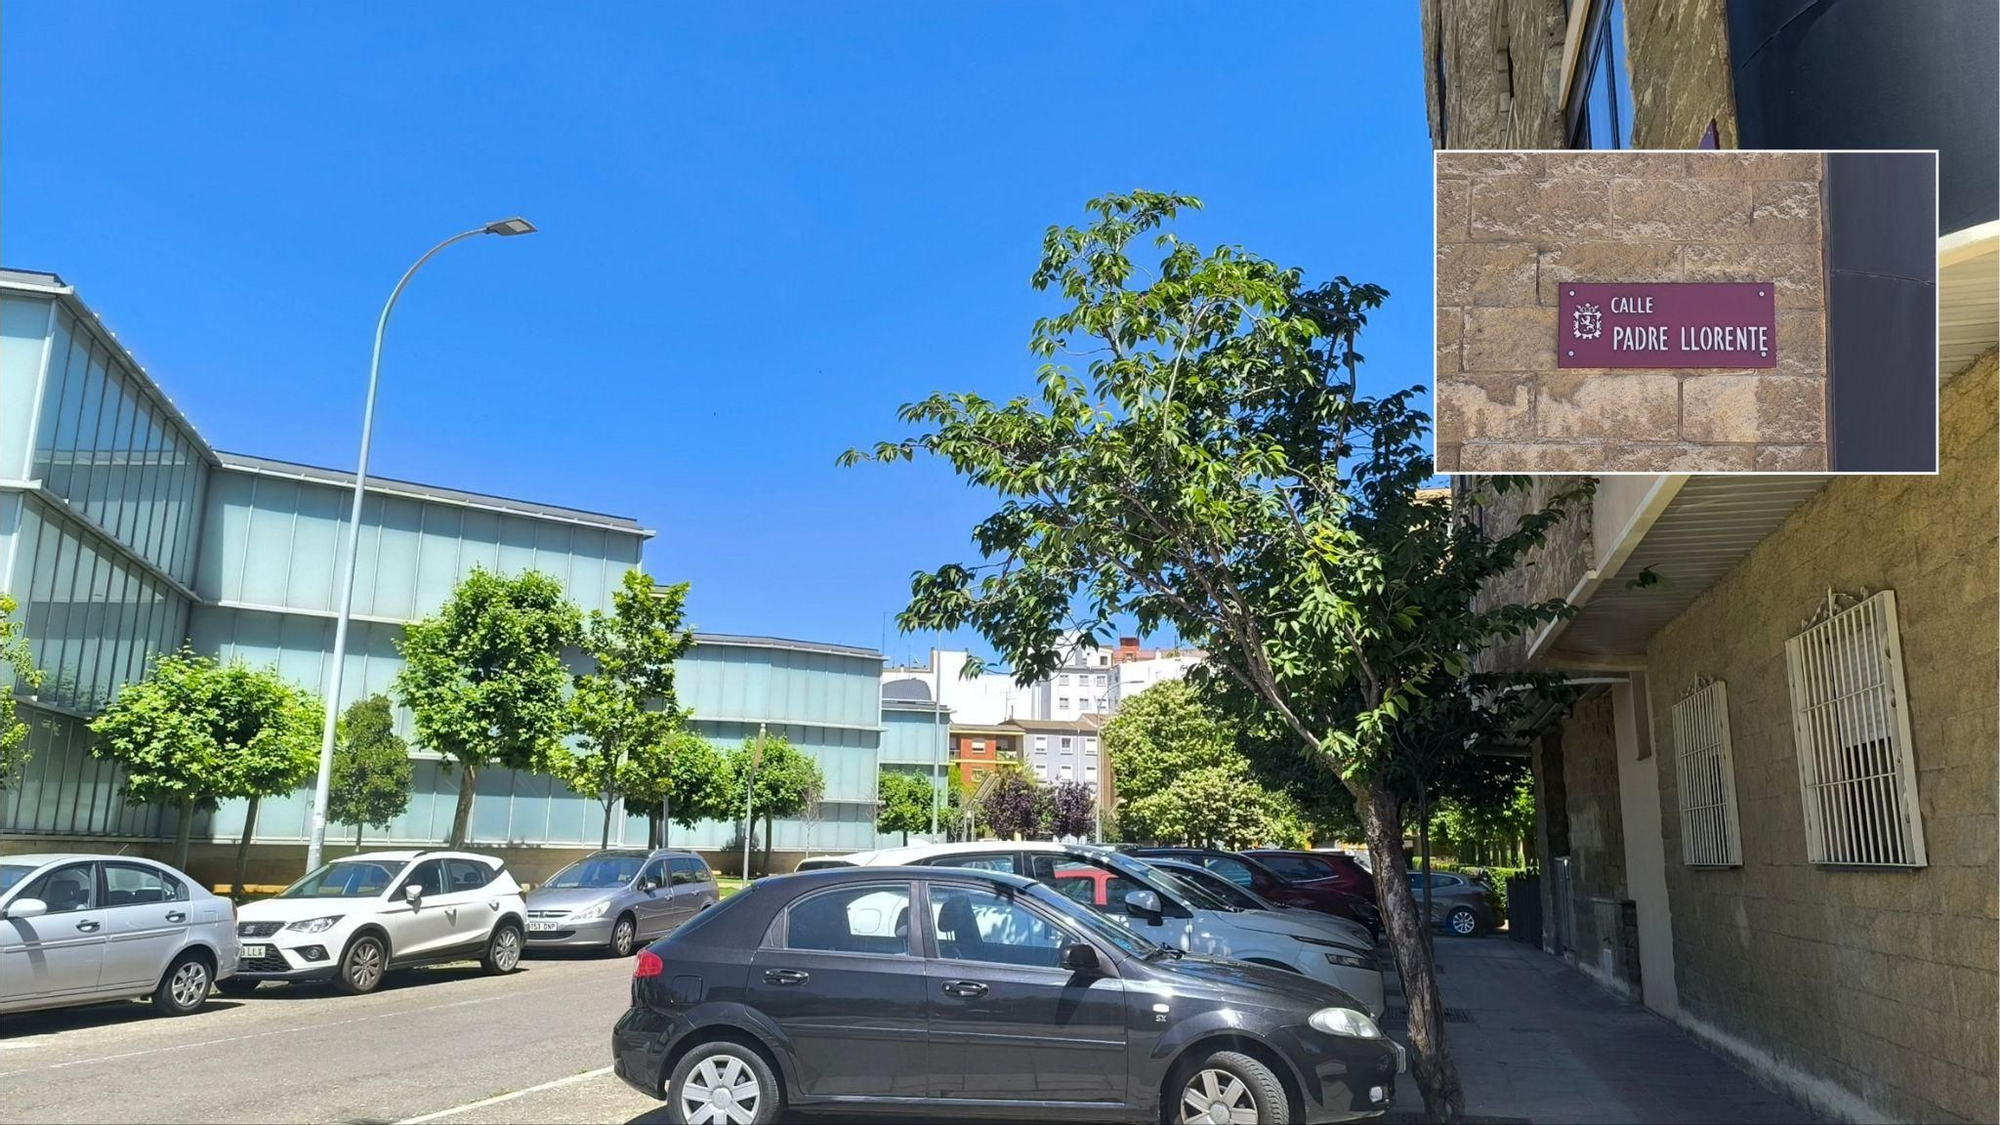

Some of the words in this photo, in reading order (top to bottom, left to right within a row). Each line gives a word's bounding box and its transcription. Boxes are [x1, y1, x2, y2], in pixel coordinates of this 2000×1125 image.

[1610, 296, 1654, 314] CALLE
[1613, 326, 1669, 351] PADRE
[1681, 326, 1769, 351] LLORENTE
[1155, 1014, 1167, 1023] SX
